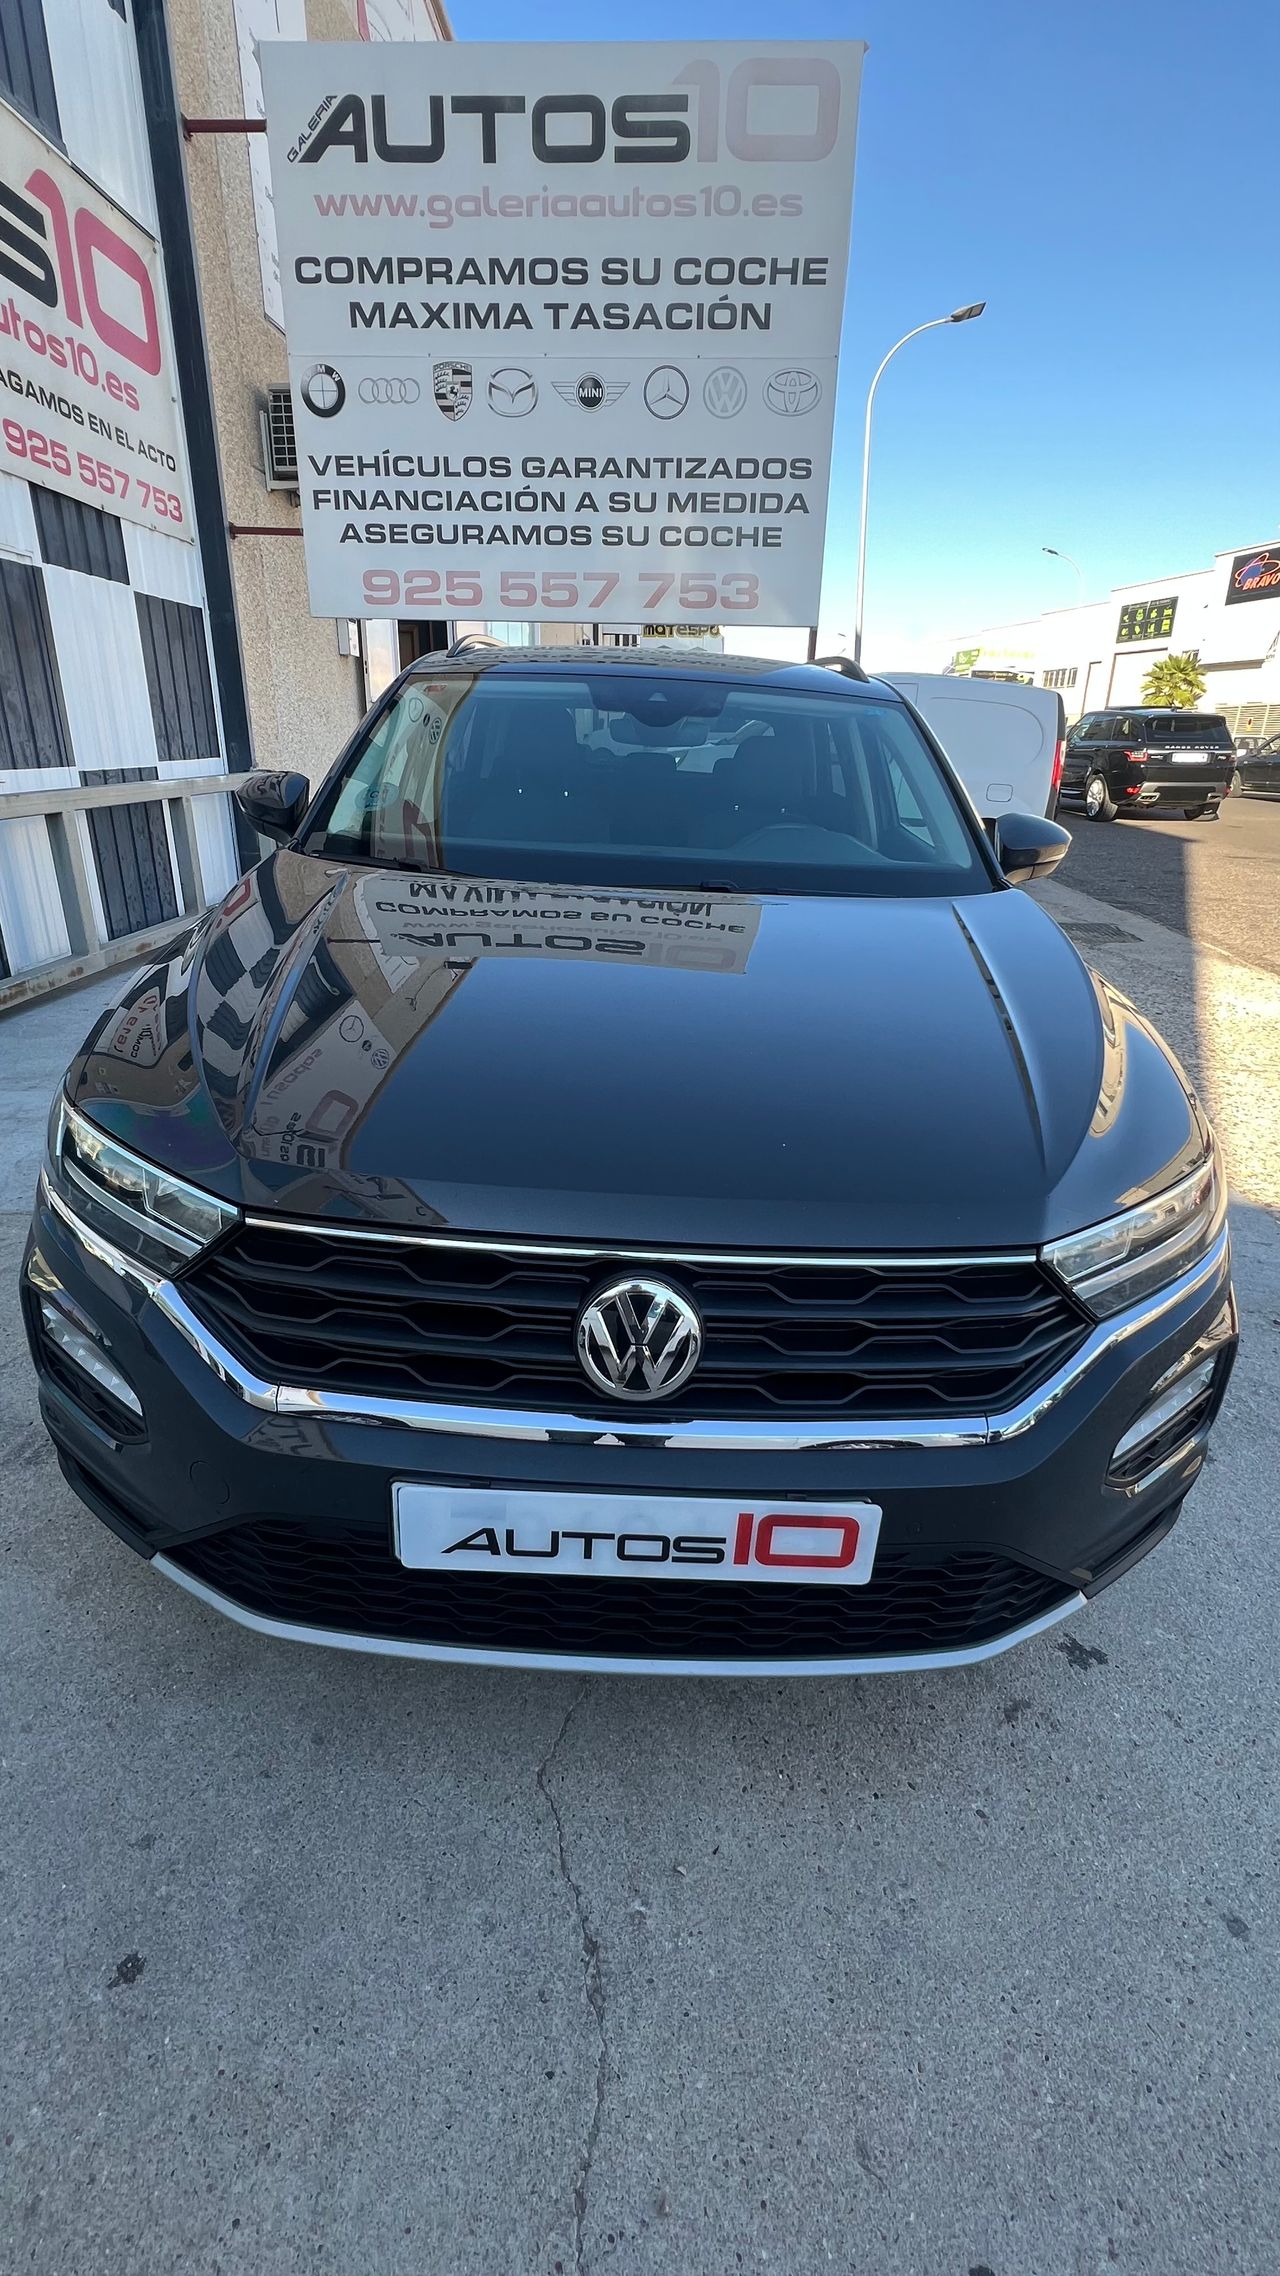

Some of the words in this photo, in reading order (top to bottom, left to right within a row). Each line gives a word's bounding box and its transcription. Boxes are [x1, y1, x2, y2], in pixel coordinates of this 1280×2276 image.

[287, 95, 338, 163] GALERIA
[314, 185, 803, 228] www.galeriaautos10.es
[295, 256, 589, 286] COMPRAMOS
[601, 257, 661, 286] SU
[674, 257, 829, 286] COCHE
[349, 301, 534, 330] MAXIMA
[543, 294, 771, 330] TASACIÓN
[579, 387, 602, 398] MINI
[88, 412, 112, 440] EN
[115, 427, 135, 452] EL
[138, 440, 176, 472] ACTO
[3, 418, 72, 476] 925
[77, 451, 130, 499] 557
[136, 479, 183, 523] 753
[308, 449, 511, 477] VEHÍCULOS
[521, 456, 812, 480] GARANTIZADOS
[312, 485, 565, 512] FINANCIACIÓN
[575, 492, 600, 513] A
[608, 492, 657, 513] SU
[667, 492, 810, 514] MEDIDA
[339, 523, 592, 546] ASEGURAMOS
[602, 526, 649, 546] SU
[659, 526, 782, 547] COCHE
[363, 569, 483, 606] 925
[500, 571, 620, 608] 557
[638, 572, 759, 609] 753
[1242, 573, 1280, 590] BRAVO
[440, 1512, 860, 1568] AUTOS10
